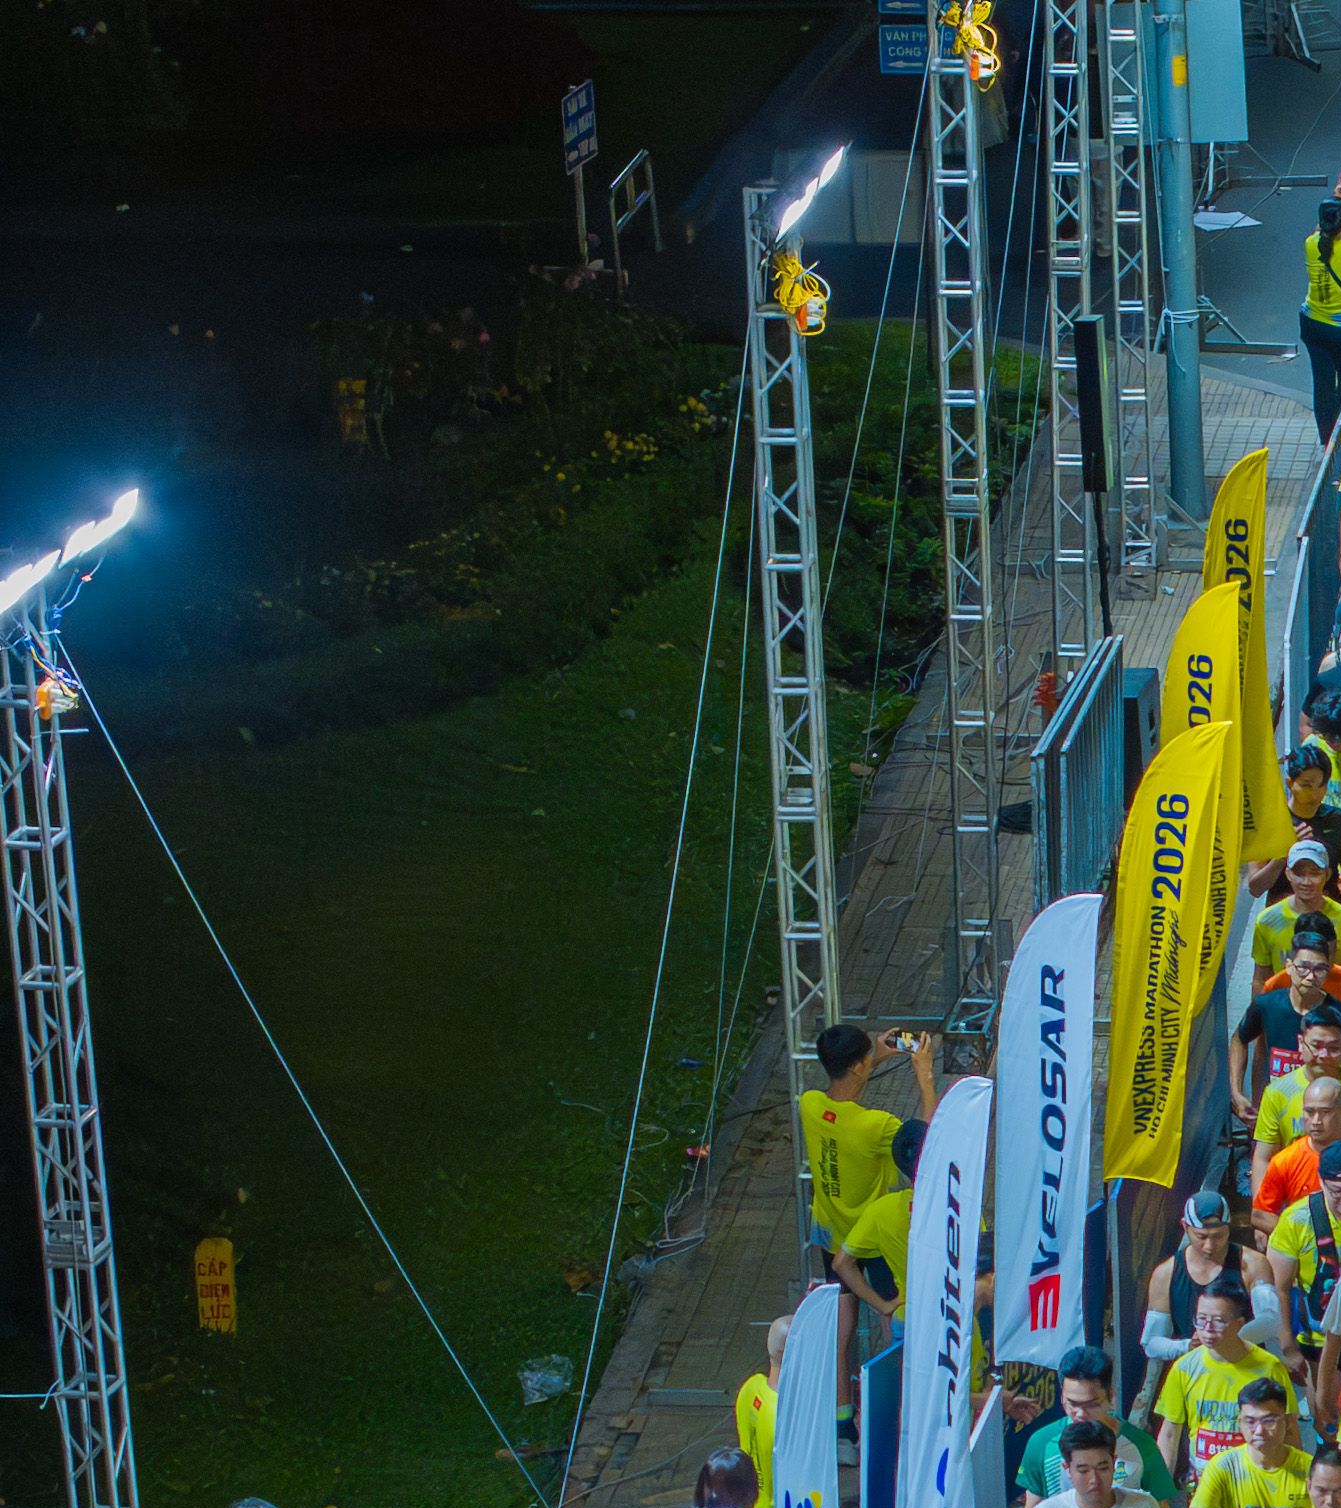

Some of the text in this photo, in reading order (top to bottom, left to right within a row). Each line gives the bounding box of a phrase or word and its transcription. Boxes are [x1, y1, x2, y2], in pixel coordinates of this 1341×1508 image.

[1151, 793, 1189, 903] 2026
[1133, 905, 1166, 1135] VNEXPRESS MARATHON
[1160, 1041, 1178, 1080] MINH
[1161, 1007, 1177, 1040] CITY
[1030, 963, 1066, 1277] VELOSAR
